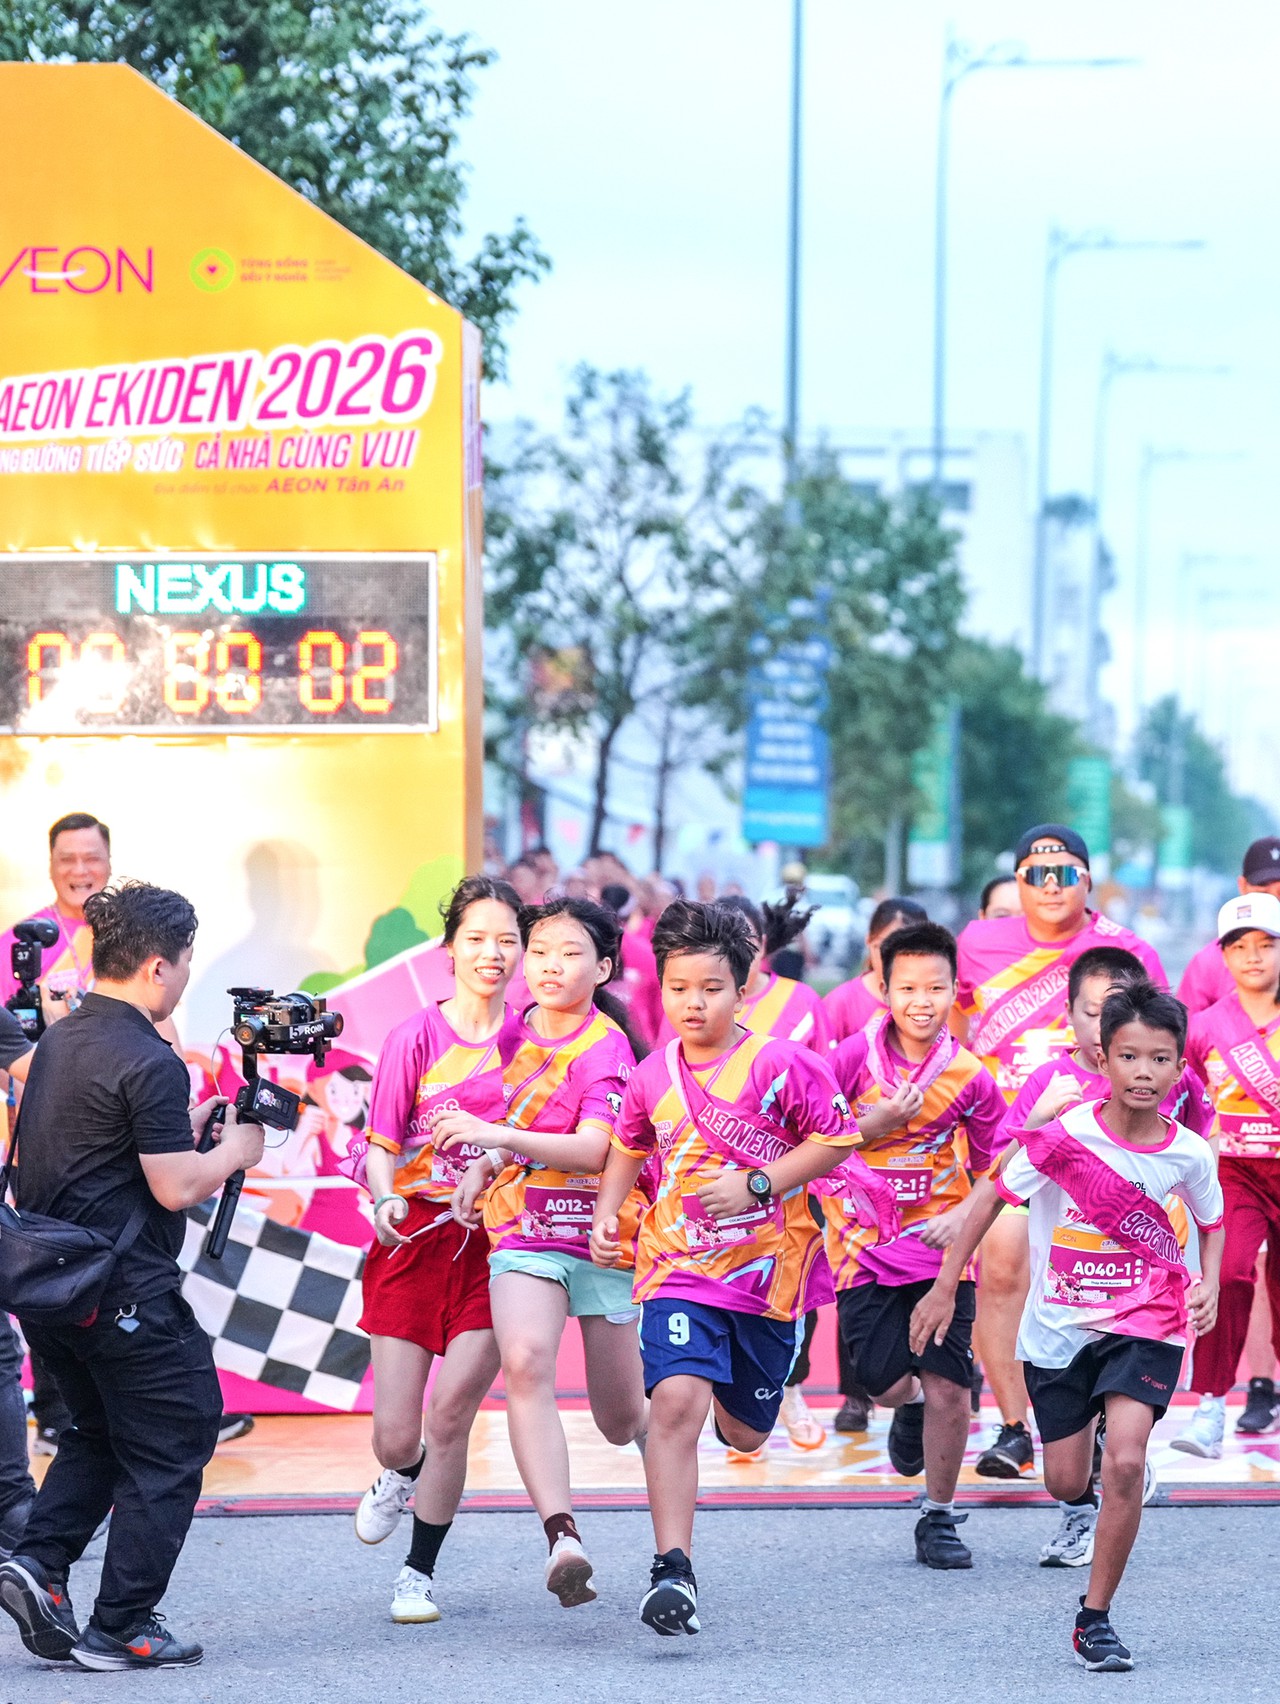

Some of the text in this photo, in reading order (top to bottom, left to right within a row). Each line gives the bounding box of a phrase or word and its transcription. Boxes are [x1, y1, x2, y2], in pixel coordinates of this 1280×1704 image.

[85, 357, 252, 428] EKIDEN
[257, 337, 434, 420] 2026
[226, 432, 270, 468] NHÀ
[278, 430, 352, 468] CÙNG
[361, 430, 420, 467] VUI
[265, 478, 327, 493] AEON
[336, 477, 370, 492] Tân
[376, 477, 405, 492] An
[116, 563, 305, 614] NEXUS
[1229, 1041, 1275, 1087] AEON
[698, 1103, 756, 1151] AEON
[1072, 1261, 1131, 1277] A040-1
[668, 1312, 690, 1346] 9
